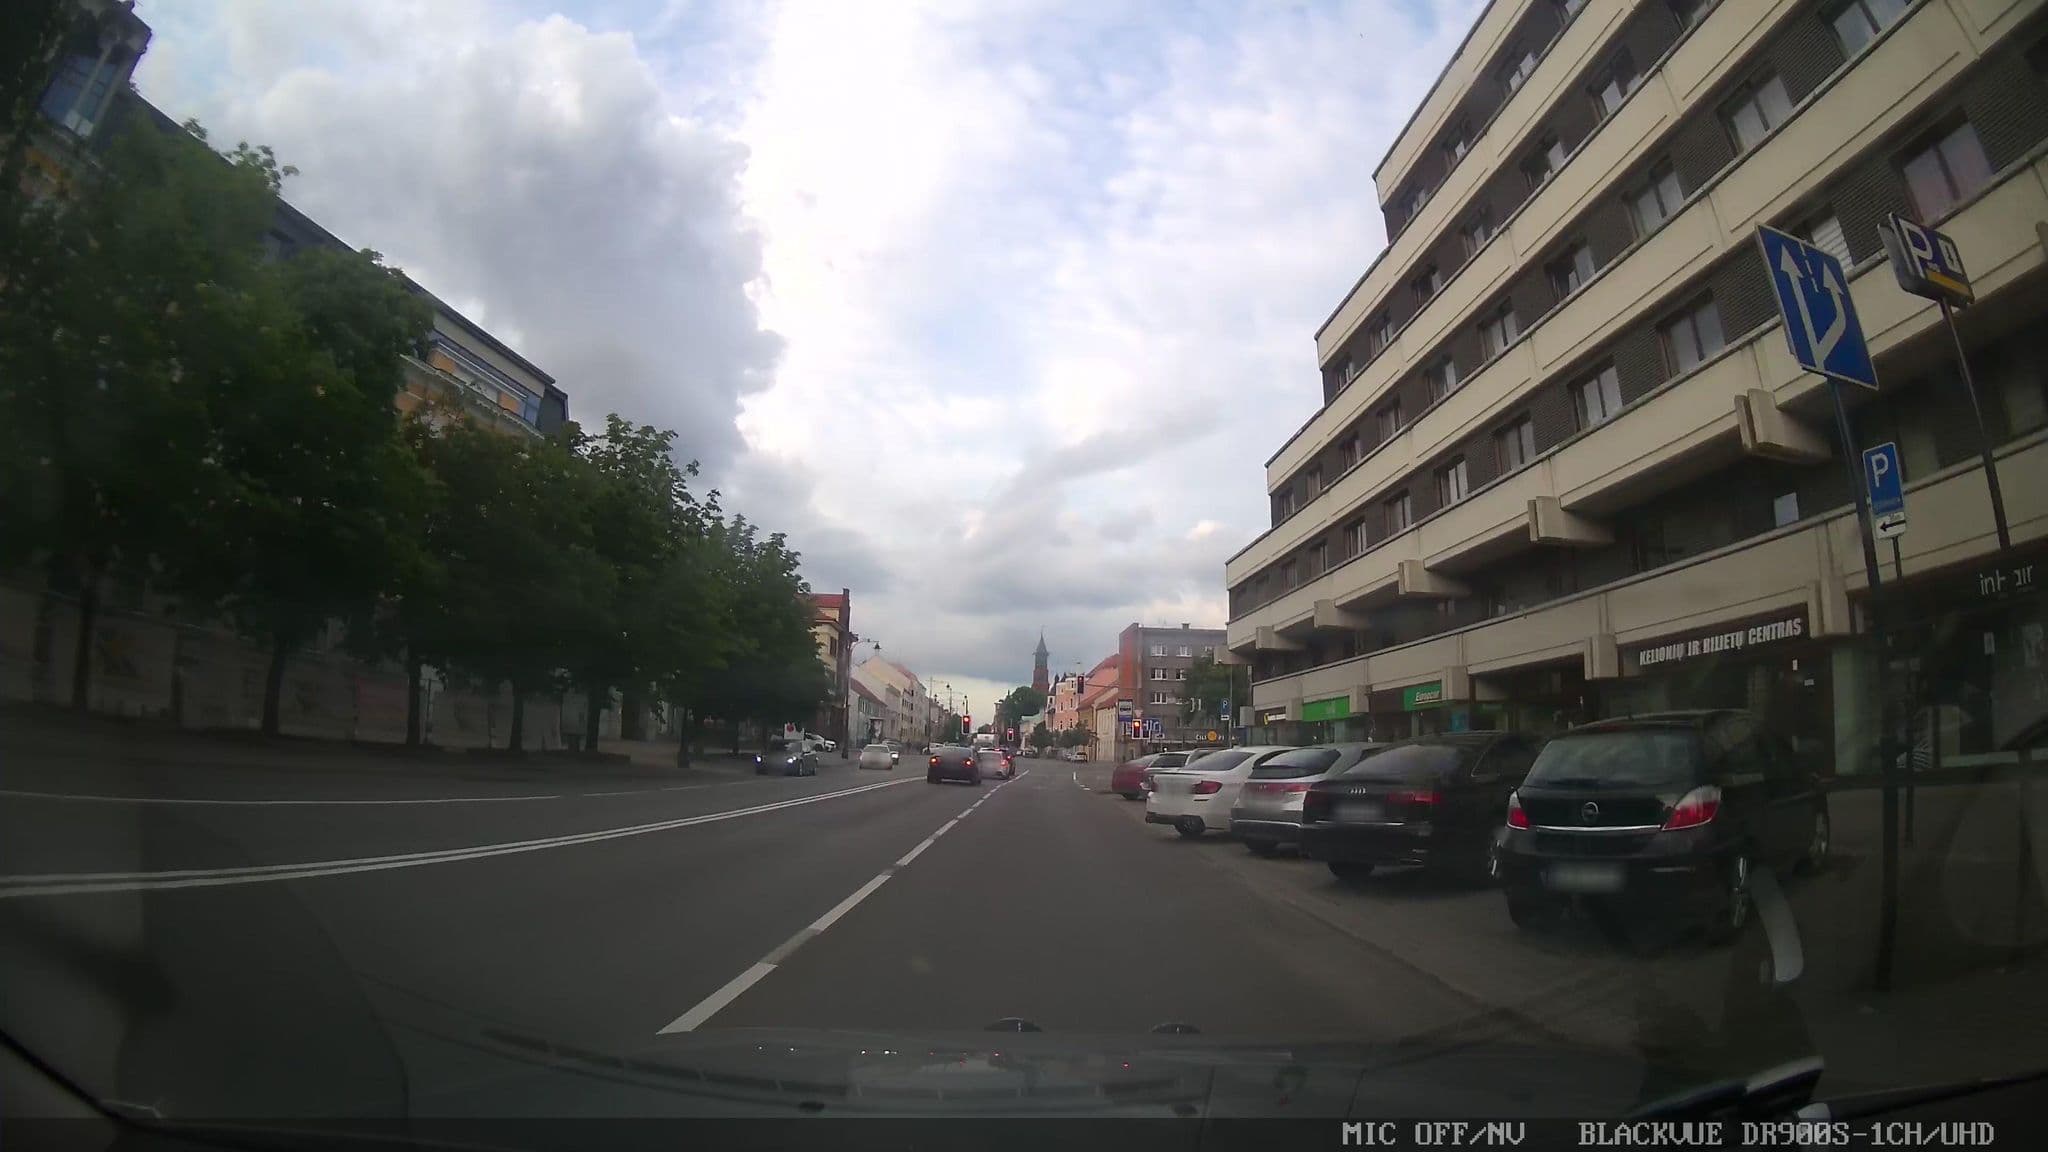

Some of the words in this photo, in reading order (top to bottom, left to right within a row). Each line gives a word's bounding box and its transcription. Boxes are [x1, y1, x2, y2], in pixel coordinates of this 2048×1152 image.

[1898, 218, 1933, 279] P
[1871, 453, 1889, 488] P
[1688, 640, 1702, 657] IR
[1748, 618, 1802, 645] CENTRAS
